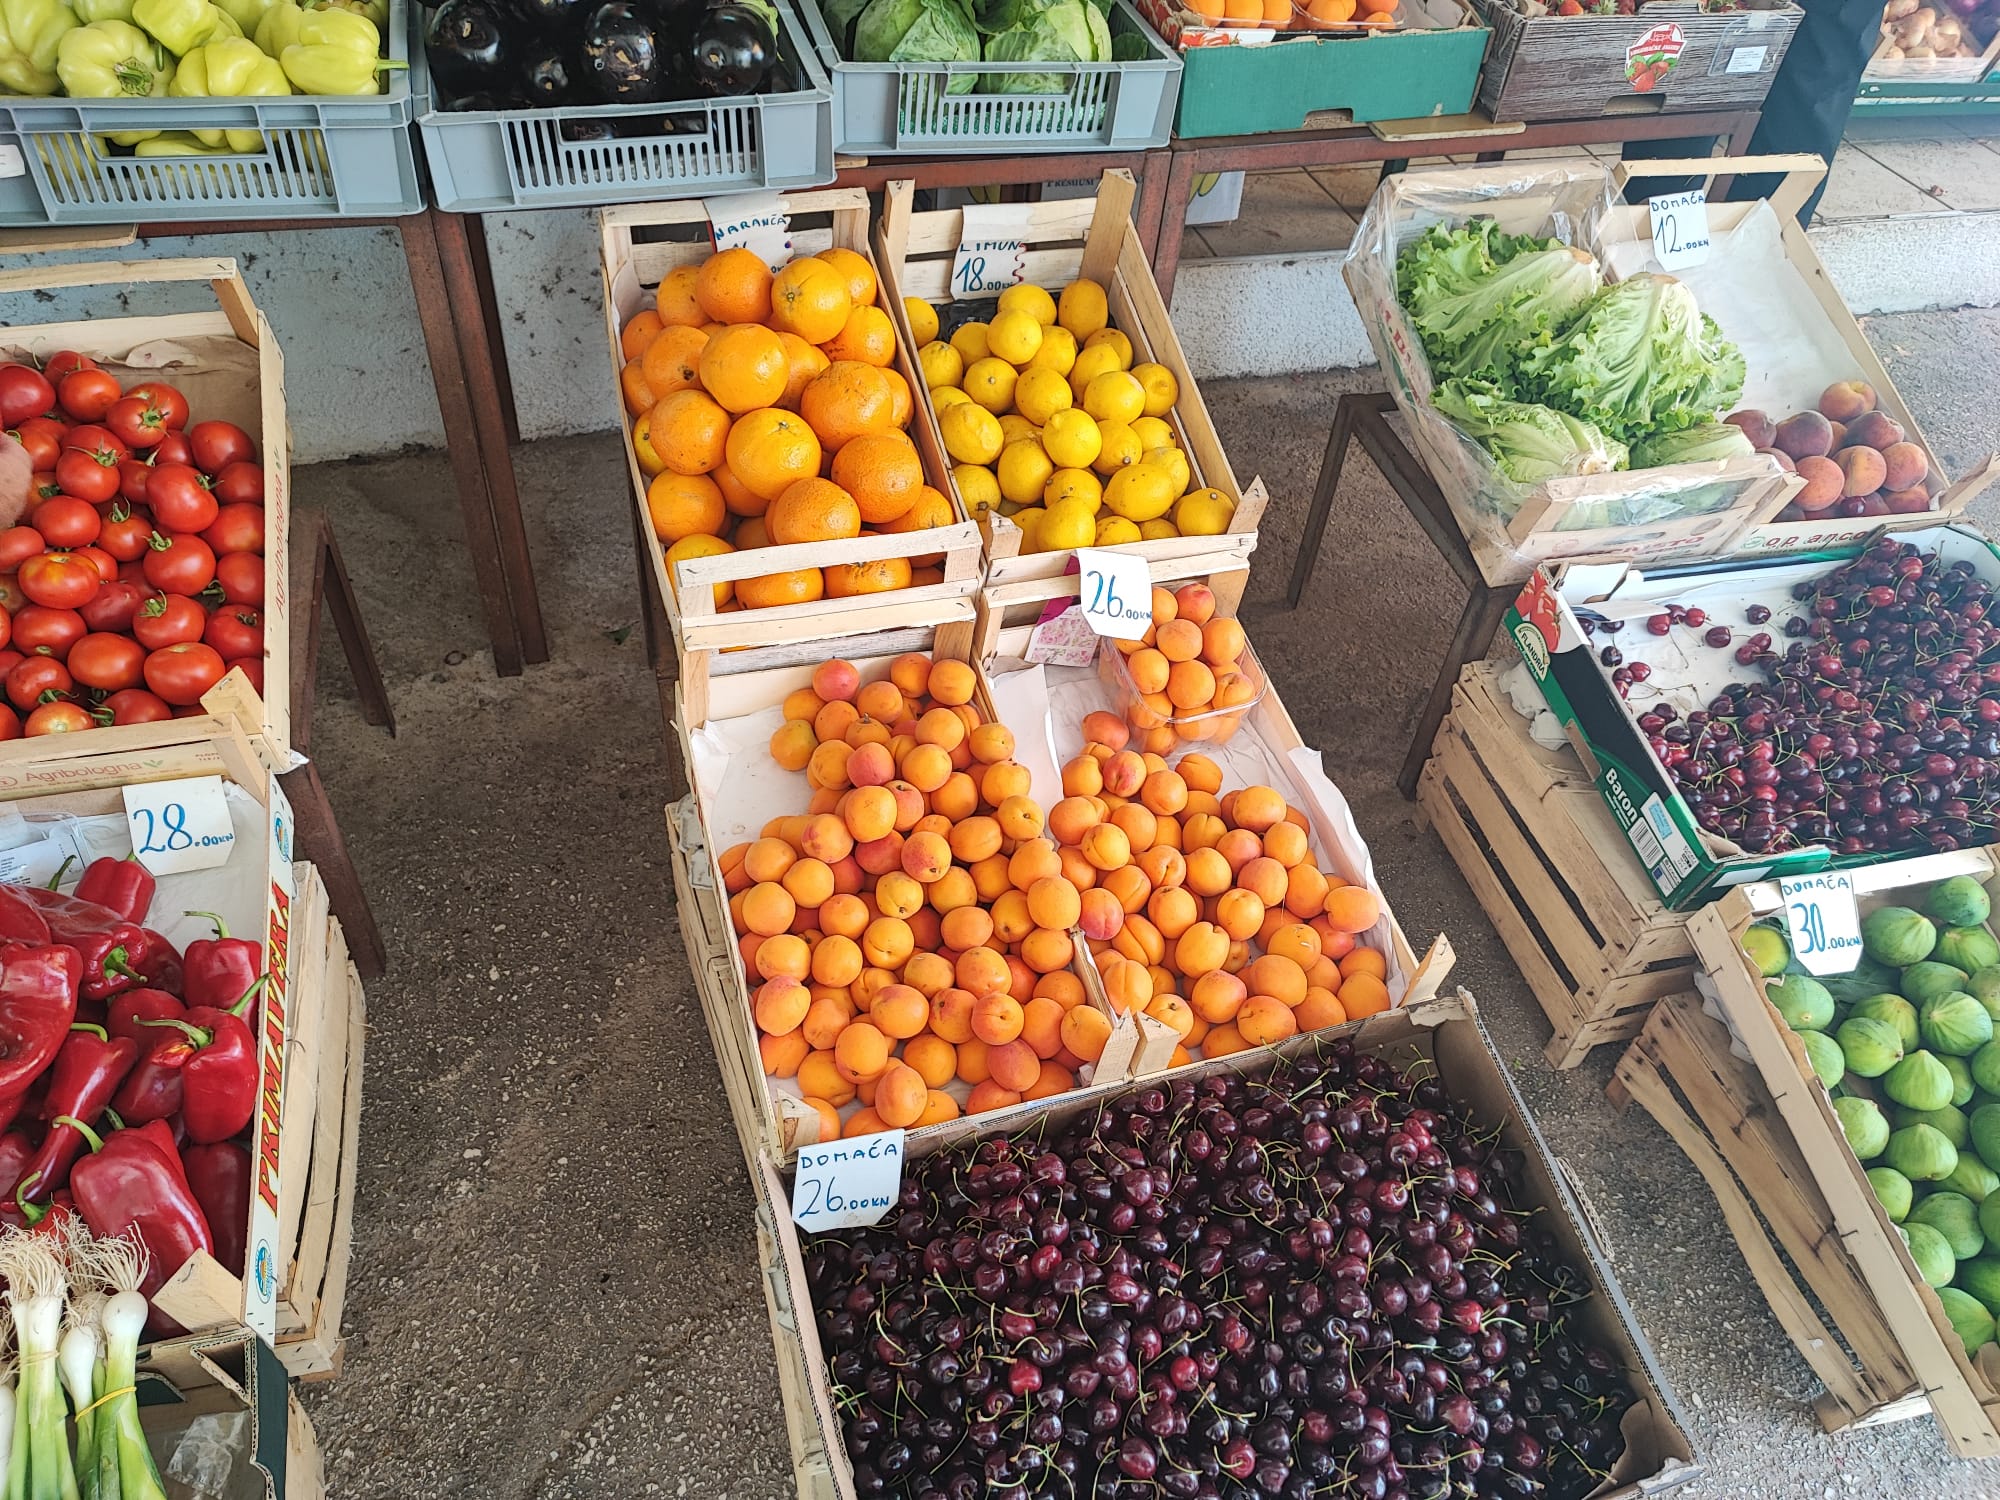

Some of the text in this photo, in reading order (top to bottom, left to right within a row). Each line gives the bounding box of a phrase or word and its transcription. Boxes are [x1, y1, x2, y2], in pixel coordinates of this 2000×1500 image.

[1650, 191, 1705, 212] DOMAĆA
[960, 241, 1022, 252] LIMUN
[1521, 631, 1546, 675] FLANDRIA
[25, 761, 142, 783] Agribologna
[1605, 767, 1638, 823] Baron
[133, 803, 234, 854] 28.00KN
[1781, 874, 1850, 896] DOMAĆA
[258, 880, 289, 1218] PRIMAVERA
[800, 1138, 898, 1169] DOMAĆA
[798, 1176, 890, 1219] 26.00KN
